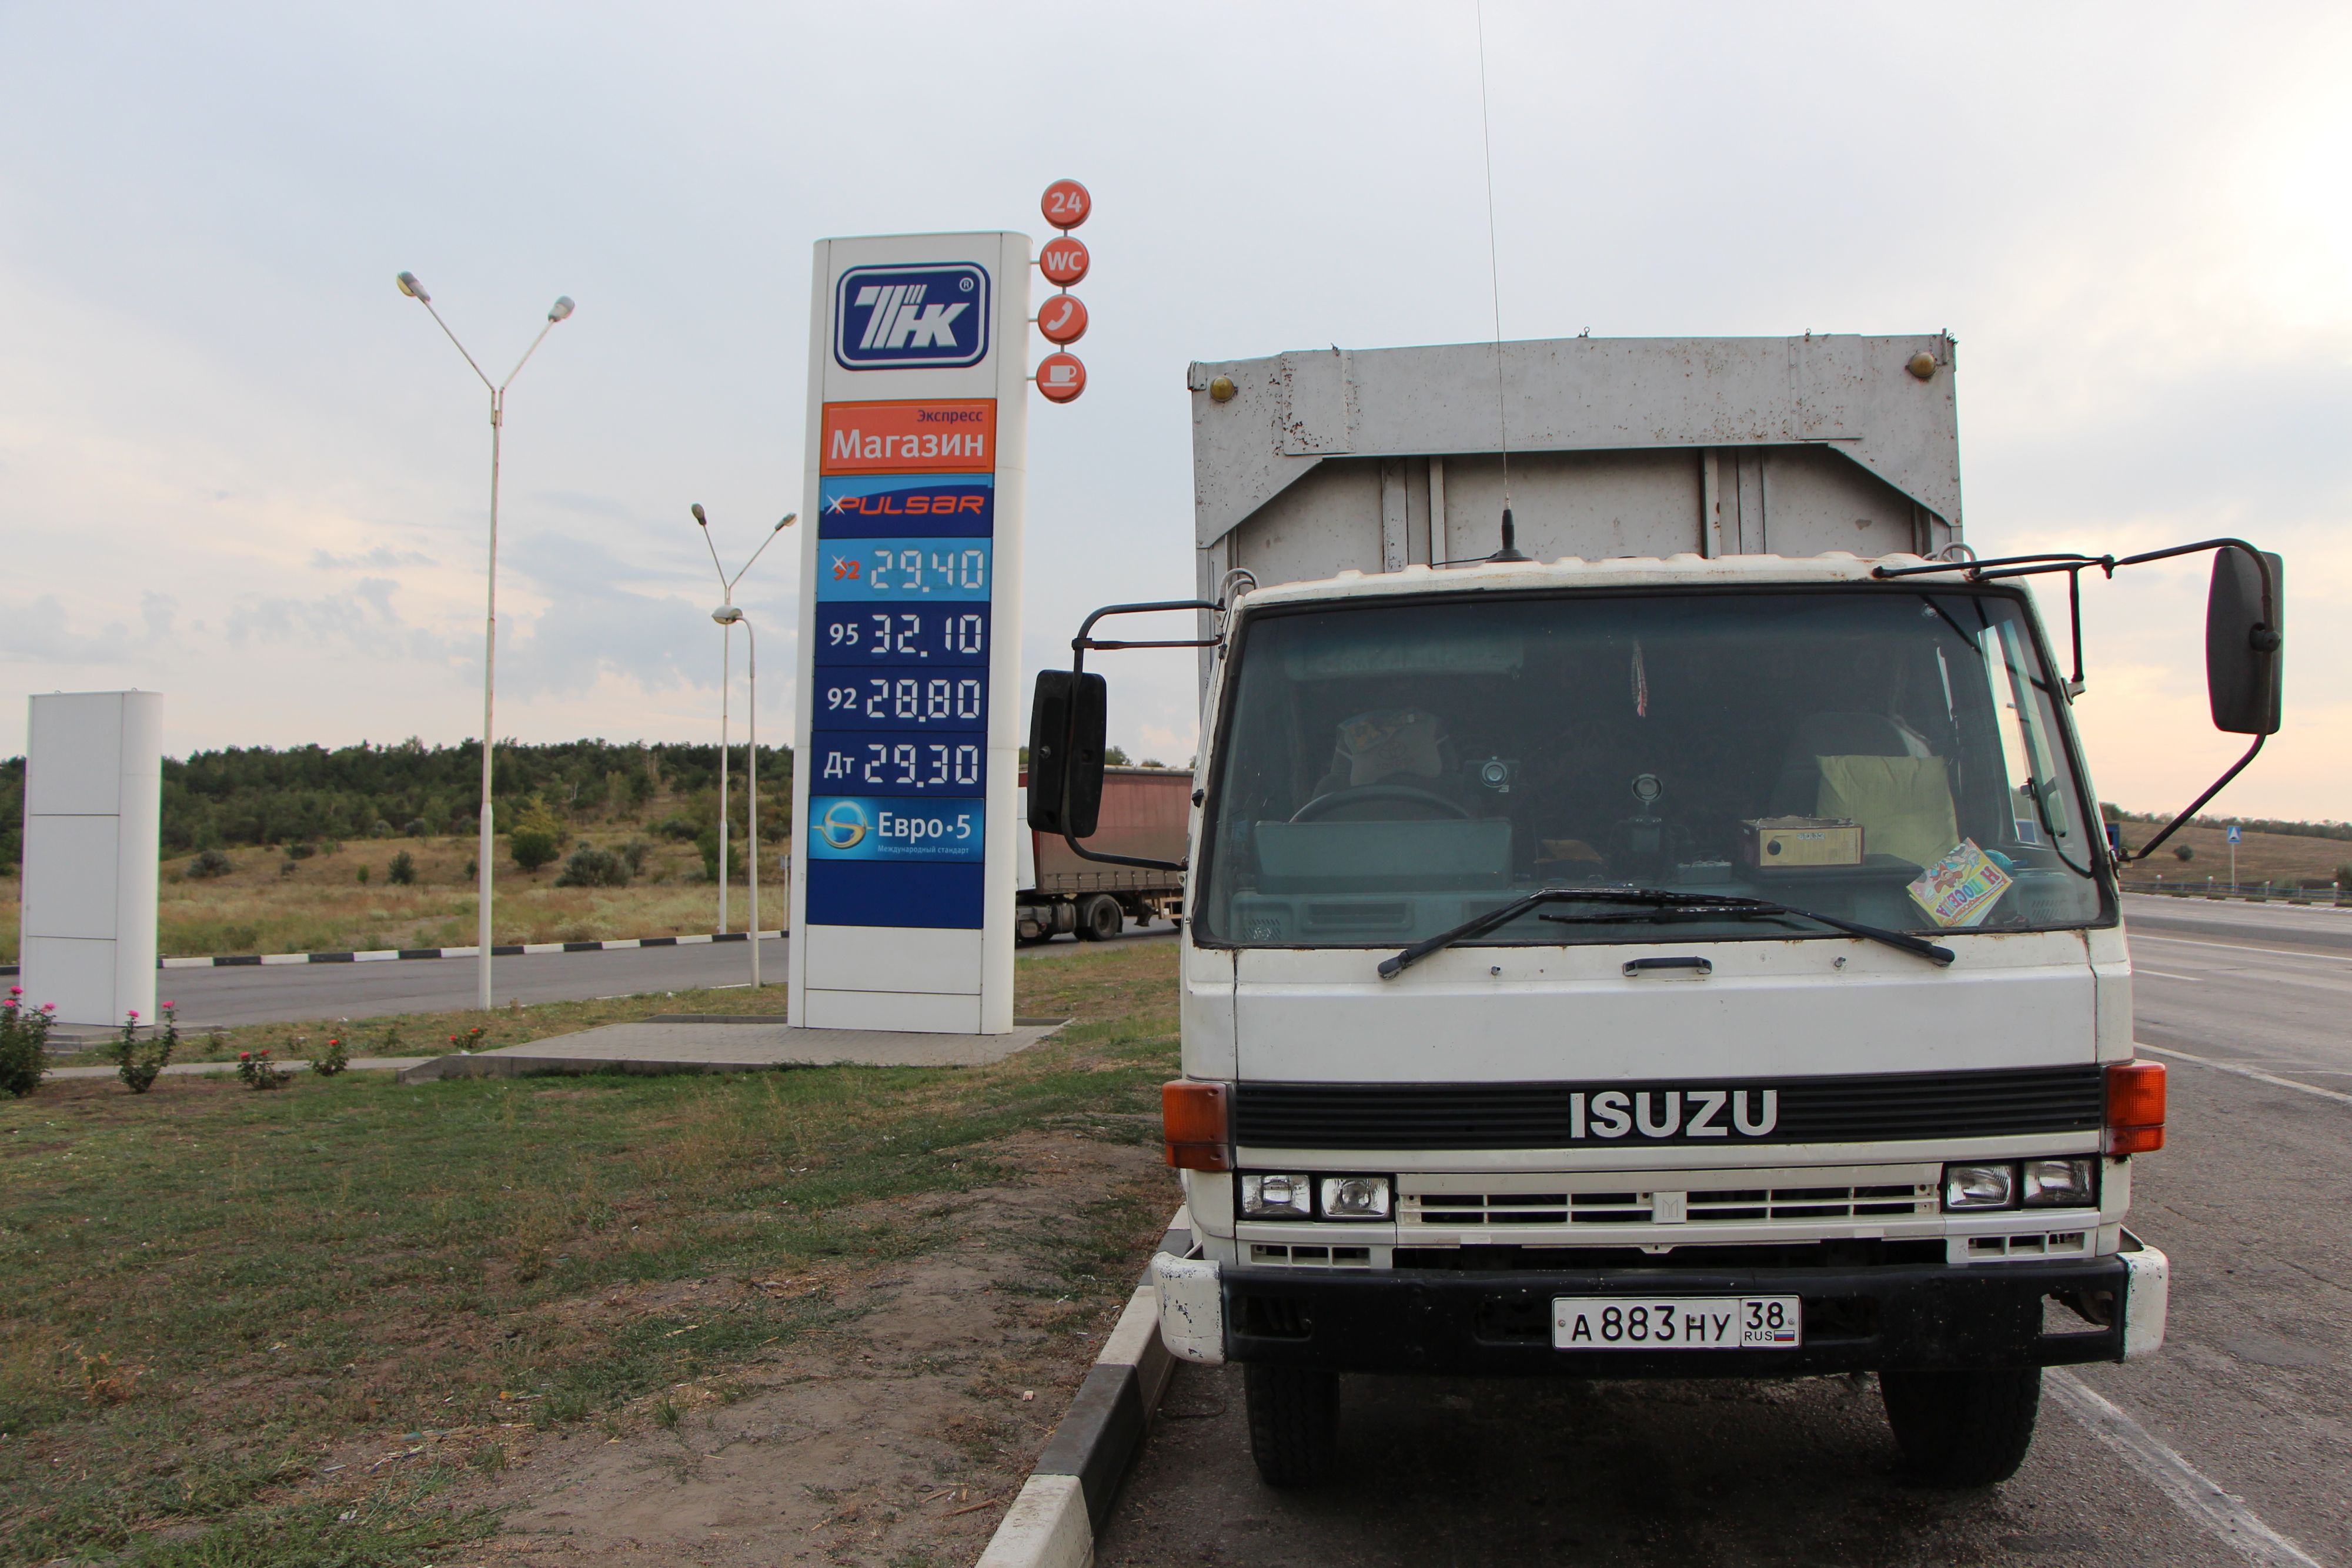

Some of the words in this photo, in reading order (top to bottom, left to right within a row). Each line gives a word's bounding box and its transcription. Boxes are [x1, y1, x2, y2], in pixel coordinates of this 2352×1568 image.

[1050, 192, 1082, 213] 24
[1047, 250, 1083, 272] WC
[854, 284, 970, 350] ТНК
[917, 410, 984, 424] Экспресс
[831, 429, 984, 459] Магазин
[871, 550, 984, 593] 29.40
[829, 623, 859, 646] 95
[870, 614, 982, 657] 32.10
[827, 687, 857, 710] 92
[867, 679, 980, 723] 28.80
[823, 751, 855, 779] Дт
[864, 744, 979, 788] 29.30
[877, 845, 936, 854] Международный
[937, 847, 969, 855] стандарт
[1570, 1089, 1778, 1139] ISUZU
[1745, 1301, 1785, 1329] 38
[1743, 1330, 1773, 1342] RUS
